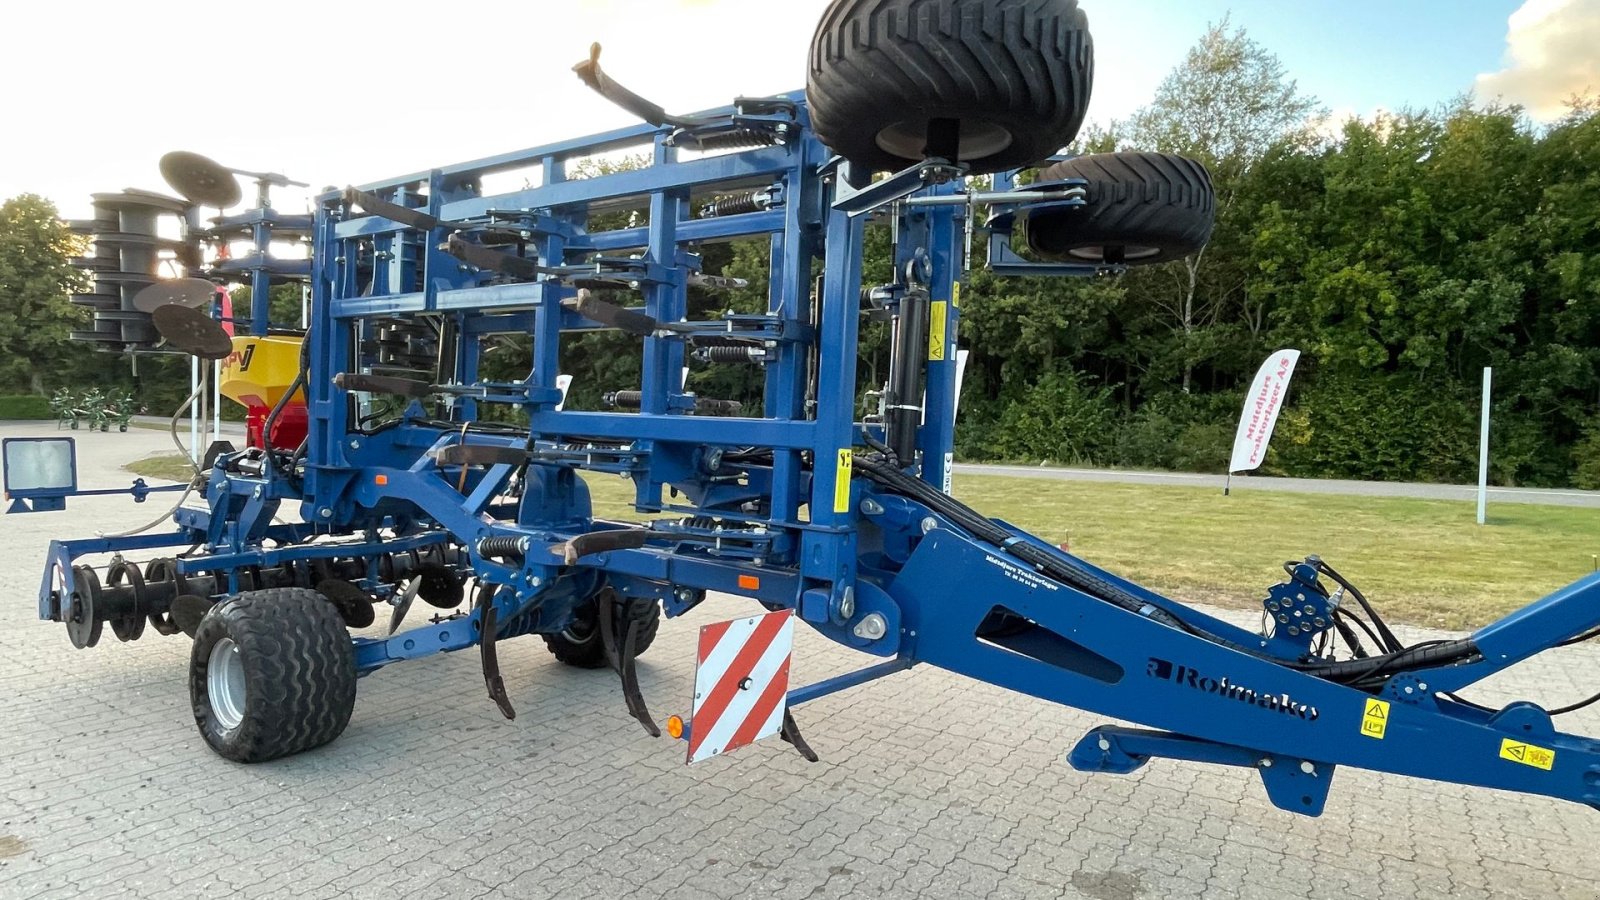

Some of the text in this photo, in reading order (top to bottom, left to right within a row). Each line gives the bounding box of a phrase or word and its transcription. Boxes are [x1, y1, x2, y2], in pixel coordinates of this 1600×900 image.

[1246, 375, 1271, 440] Midtdjurs
[1249, 358, 1290, 464] Traktorlager A/S
[1176, 665, 1320, 721] Rolmako
